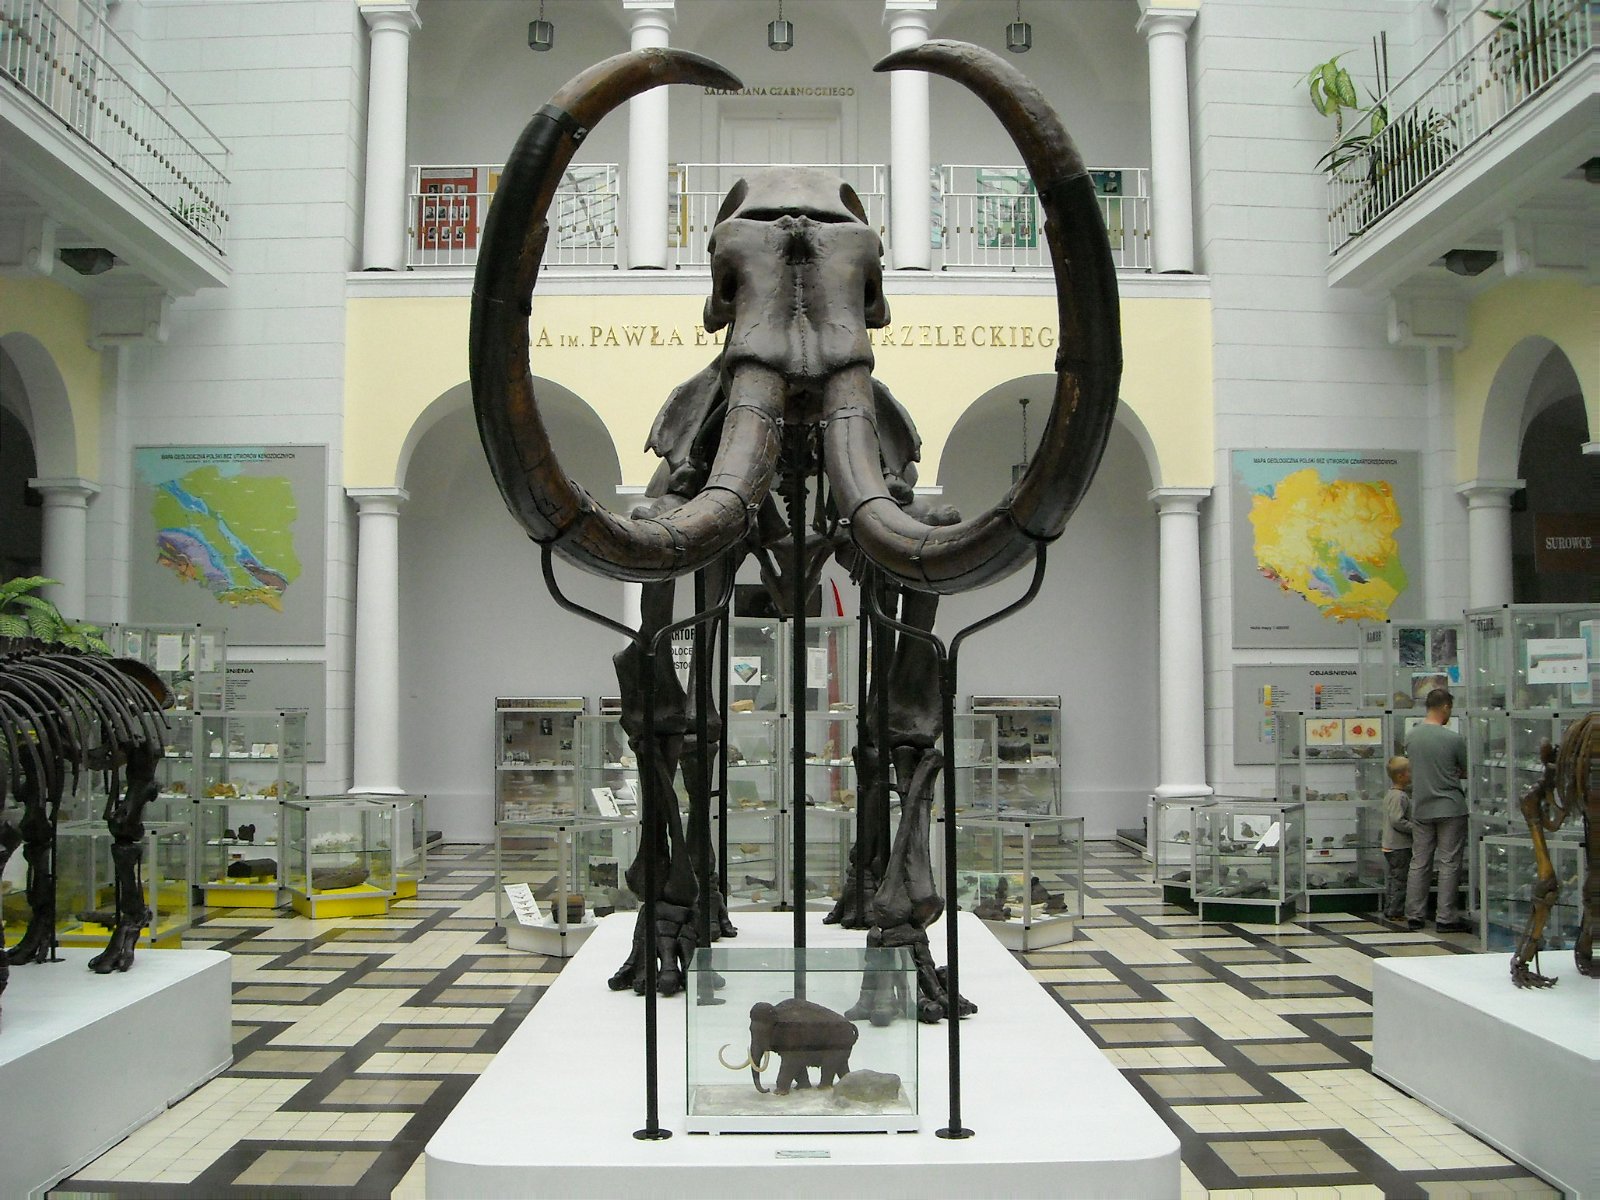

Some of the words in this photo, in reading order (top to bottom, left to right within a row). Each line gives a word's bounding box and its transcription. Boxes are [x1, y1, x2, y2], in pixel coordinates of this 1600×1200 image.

[769, 87, 855, 97] CZARNOCKIEGO
[590, 324, 684, 347] PAWŁA
[1545, 536, 1592, 550] SUROWCE
